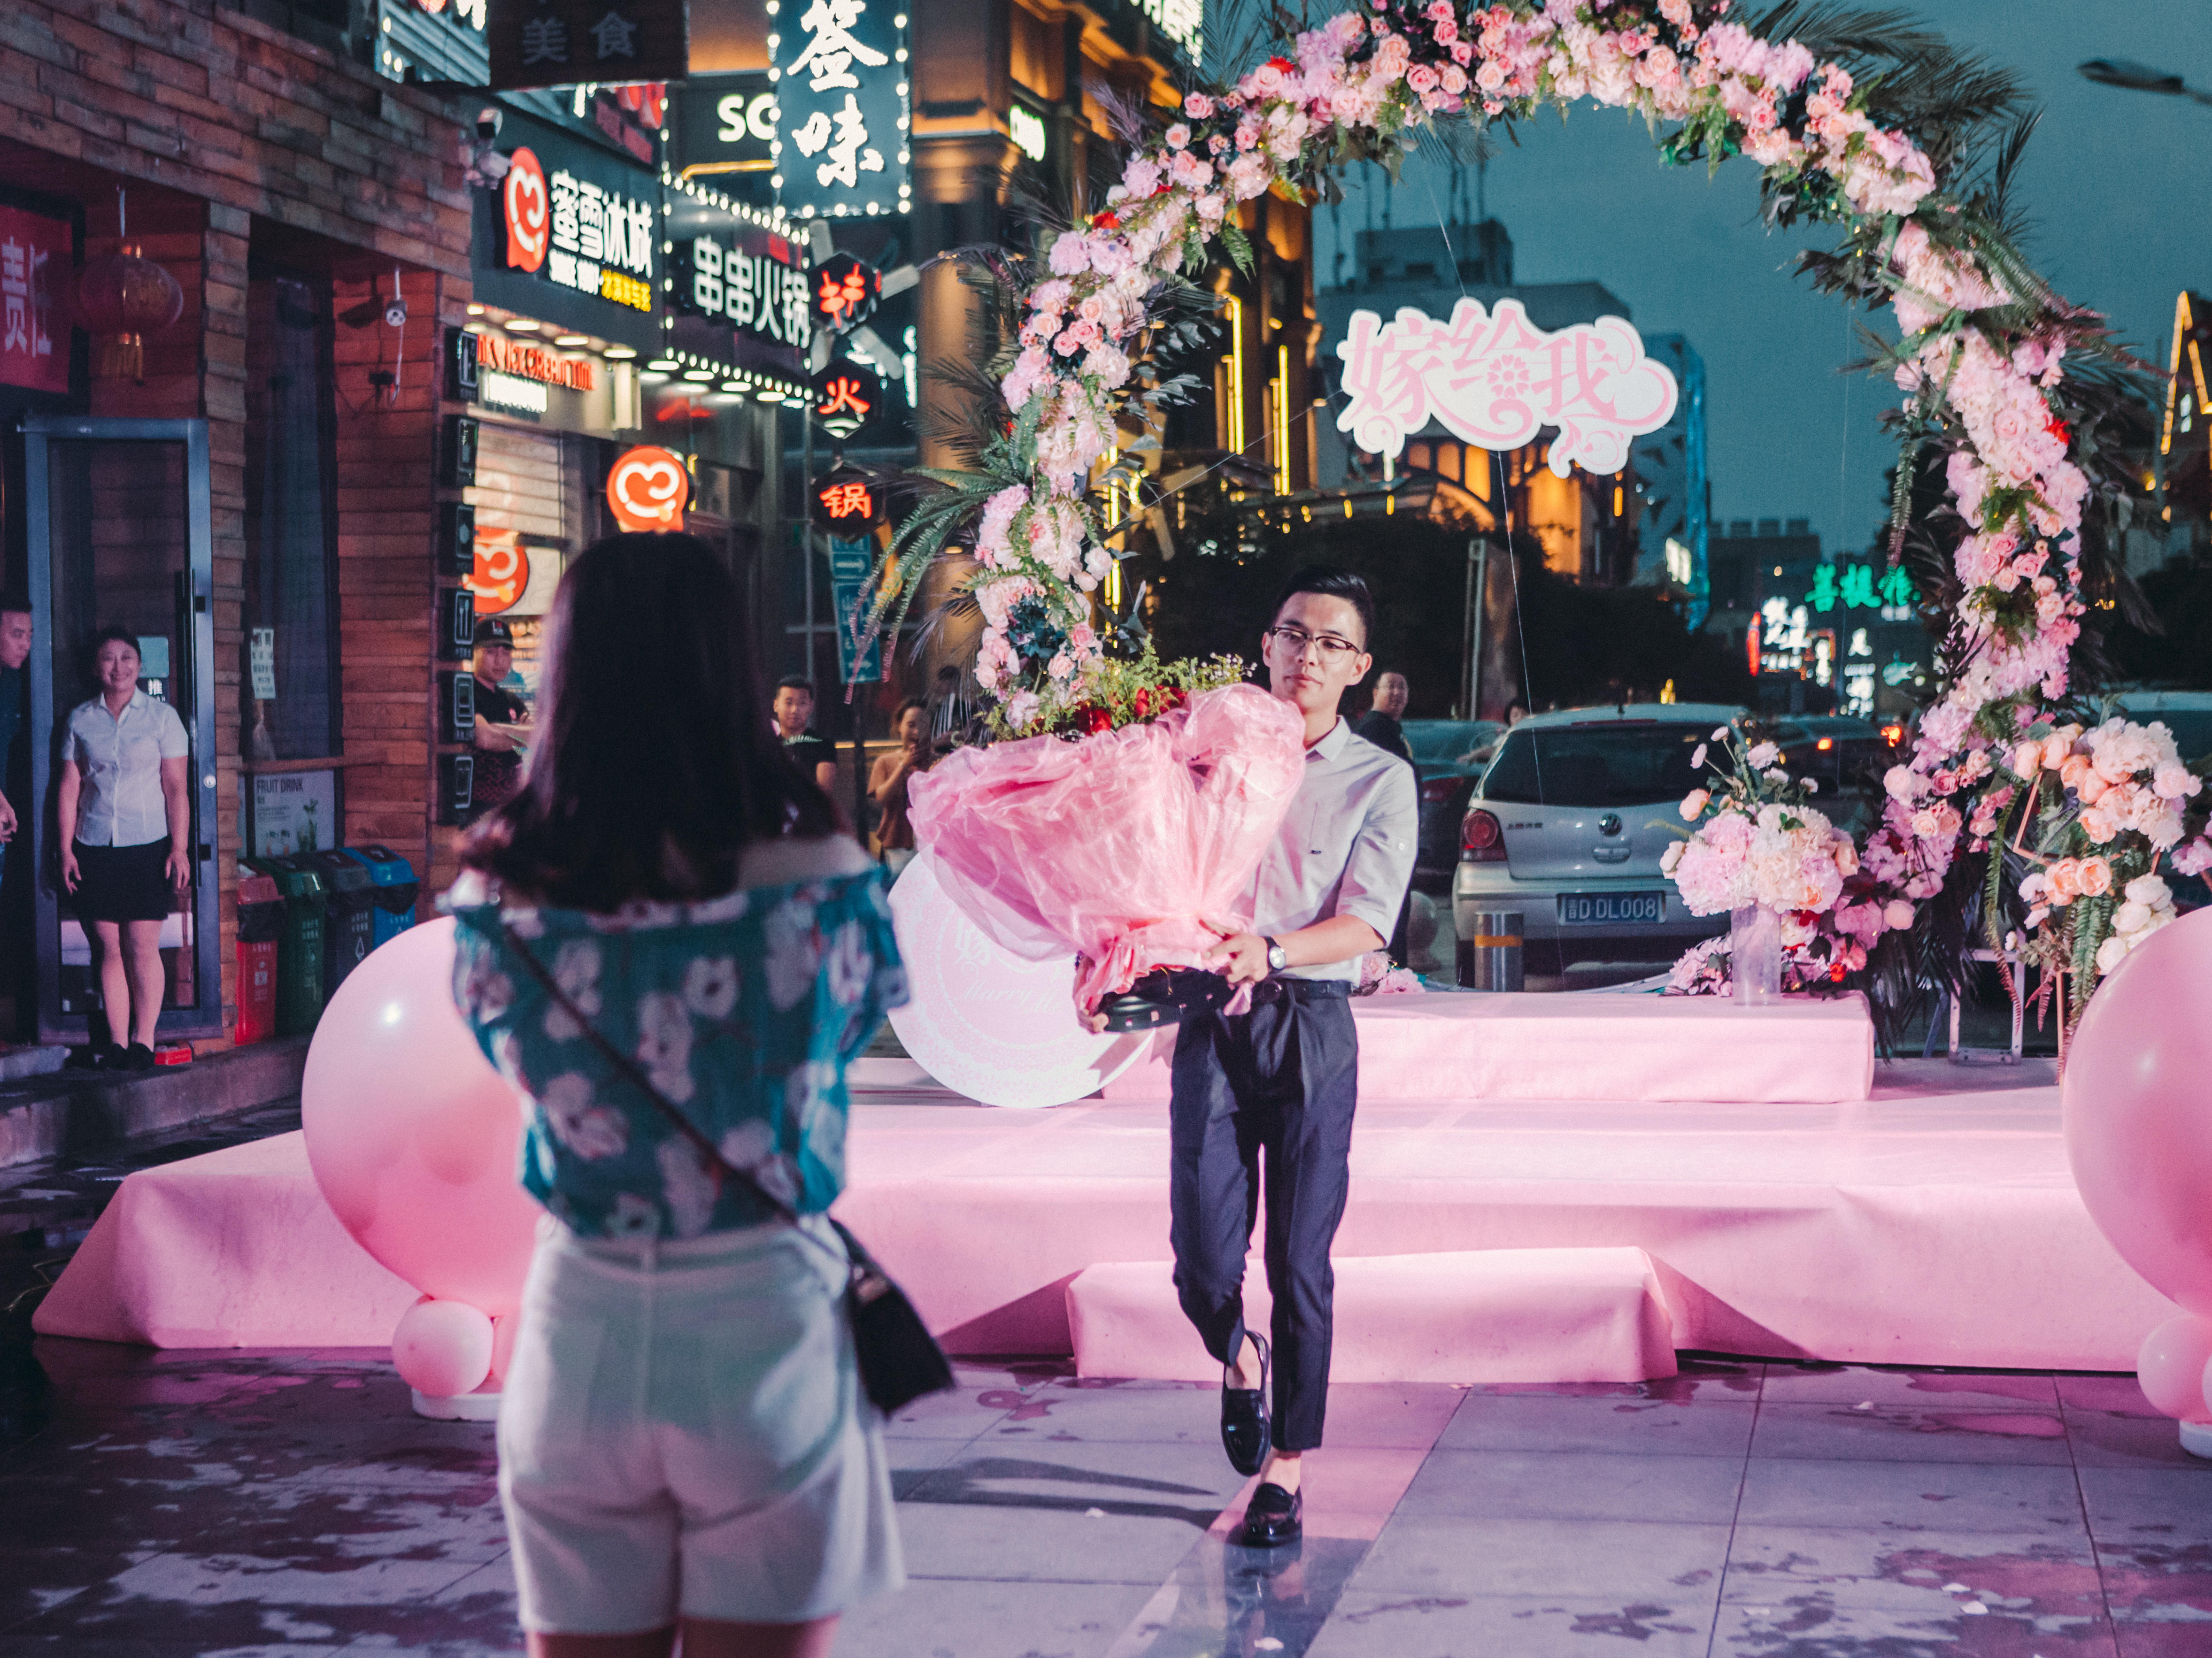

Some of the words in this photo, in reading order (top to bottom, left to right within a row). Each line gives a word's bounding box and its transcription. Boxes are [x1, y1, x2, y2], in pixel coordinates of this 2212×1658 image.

[522, 12, 638, 65] 美食
[550, 168, 653, 279] 蜜雪冰城
[694, 234, 811, 349] 串串火锅
[1343, 306, 1634, 434] 嫁给我
[818, 376, 871, 414] 火
[819, 482, 872, 519] 锅
[256, 779, 279, 793] FRUIT
[280, 779, 303, 793] DRINK
[1596, 898, 1656, 919] DL008
[961, 977, 1033, 1006] Marry
